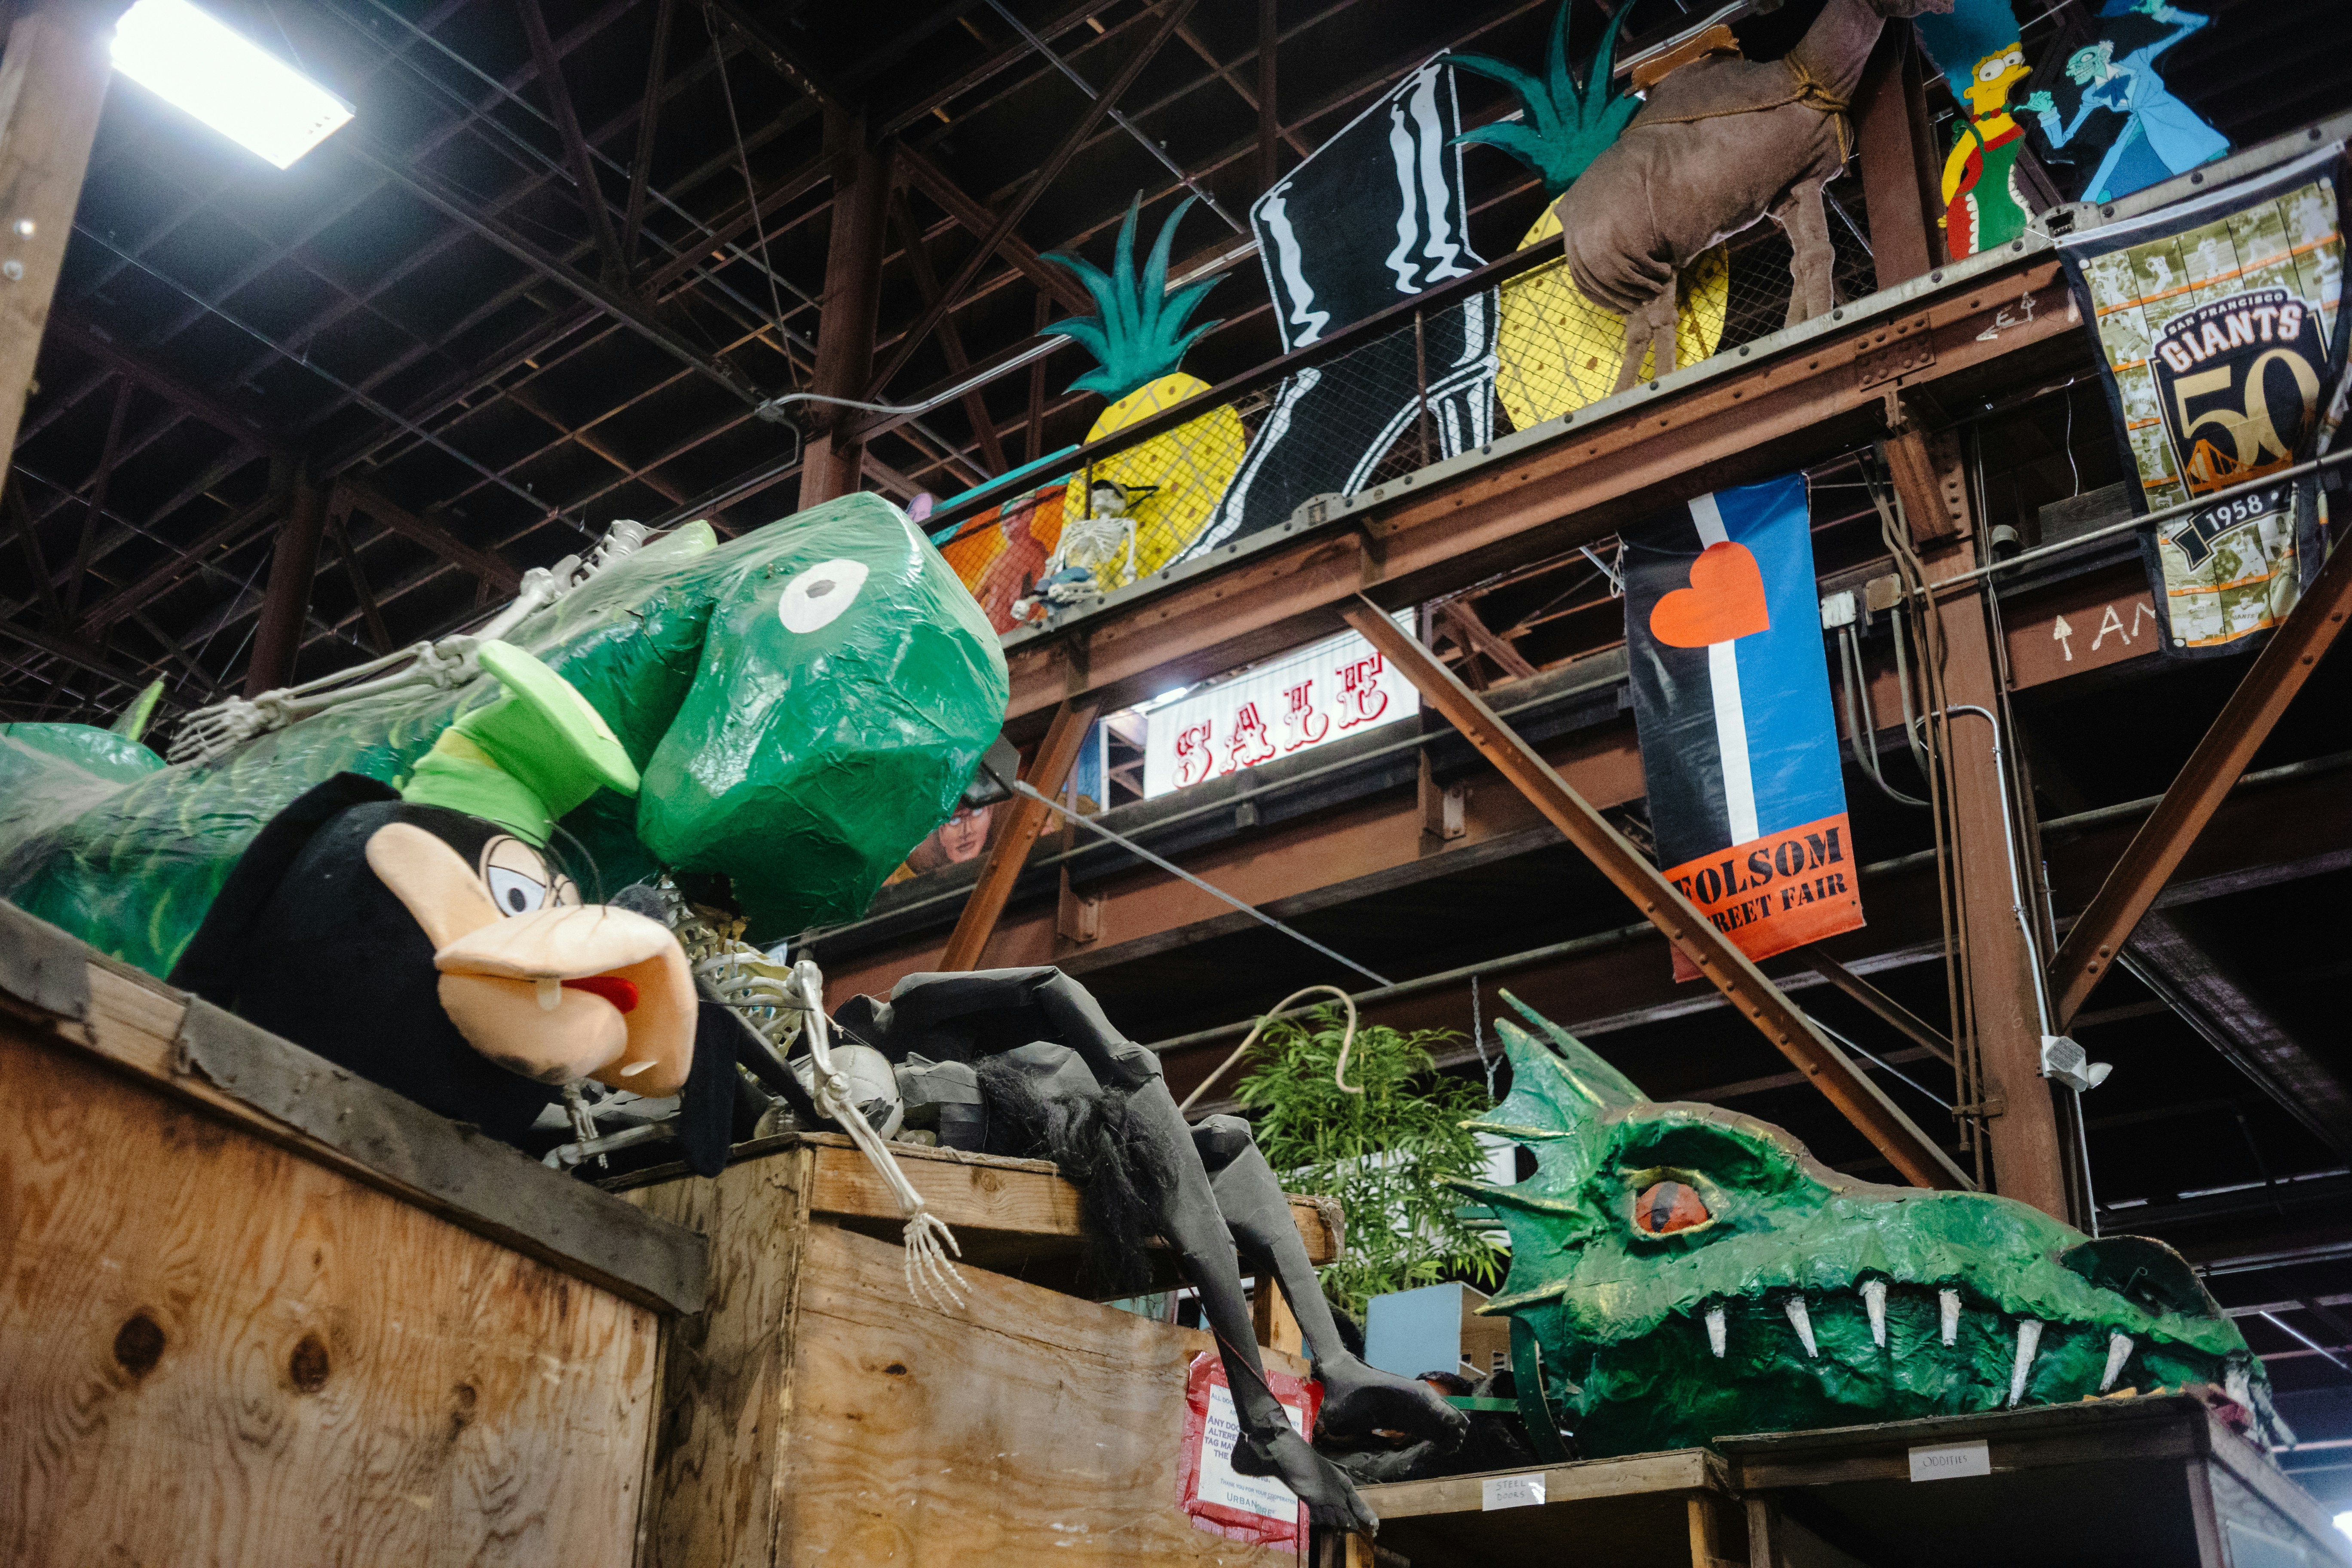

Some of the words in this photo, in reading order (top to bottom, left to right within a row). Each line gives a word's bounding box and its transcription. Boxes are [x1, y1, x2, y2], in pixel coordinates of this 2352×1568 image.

[2168, 317, 2195, 336] SAN
[2199, 292, 2284, 321] FRANCISCO
[2160, 304, 2302, 373] GIANTS
[2174, 348, 2320, 475] 50
[2205, 495, 2263, 531] 1958
[1173, 651, 1388, 789] SALE
[1671, 827, 1844, 904] FOLSOM
[1707, 894, 1772, 934] REET
[1780, 873, 1847, 911] FAIR
[1211, 1393, 1221, 1402] ALL
[1222, 1397, 1234, 1406] DOO
[1208, 1415, 1225, 1427] ANY
[1226, 1421, 1240, 1433] DOO
[1204, 1436, 1219, 1447] TAG
[1208, 1427, 1238, 1442] ALTERE
[1214, 1449, 1229, 1460] THE
[1923, 1455, 1967, 1467] ODDITIES
[1220, 1478, 1235, 1488] THANK
[1245, 1485, 1254, 1493] FOR
[1496, 1480, 1526, 1491] STEEL
[1227, 1492, 1257, 1507] URBAN
[1497, 1490, 1525, 1501] DOORS
